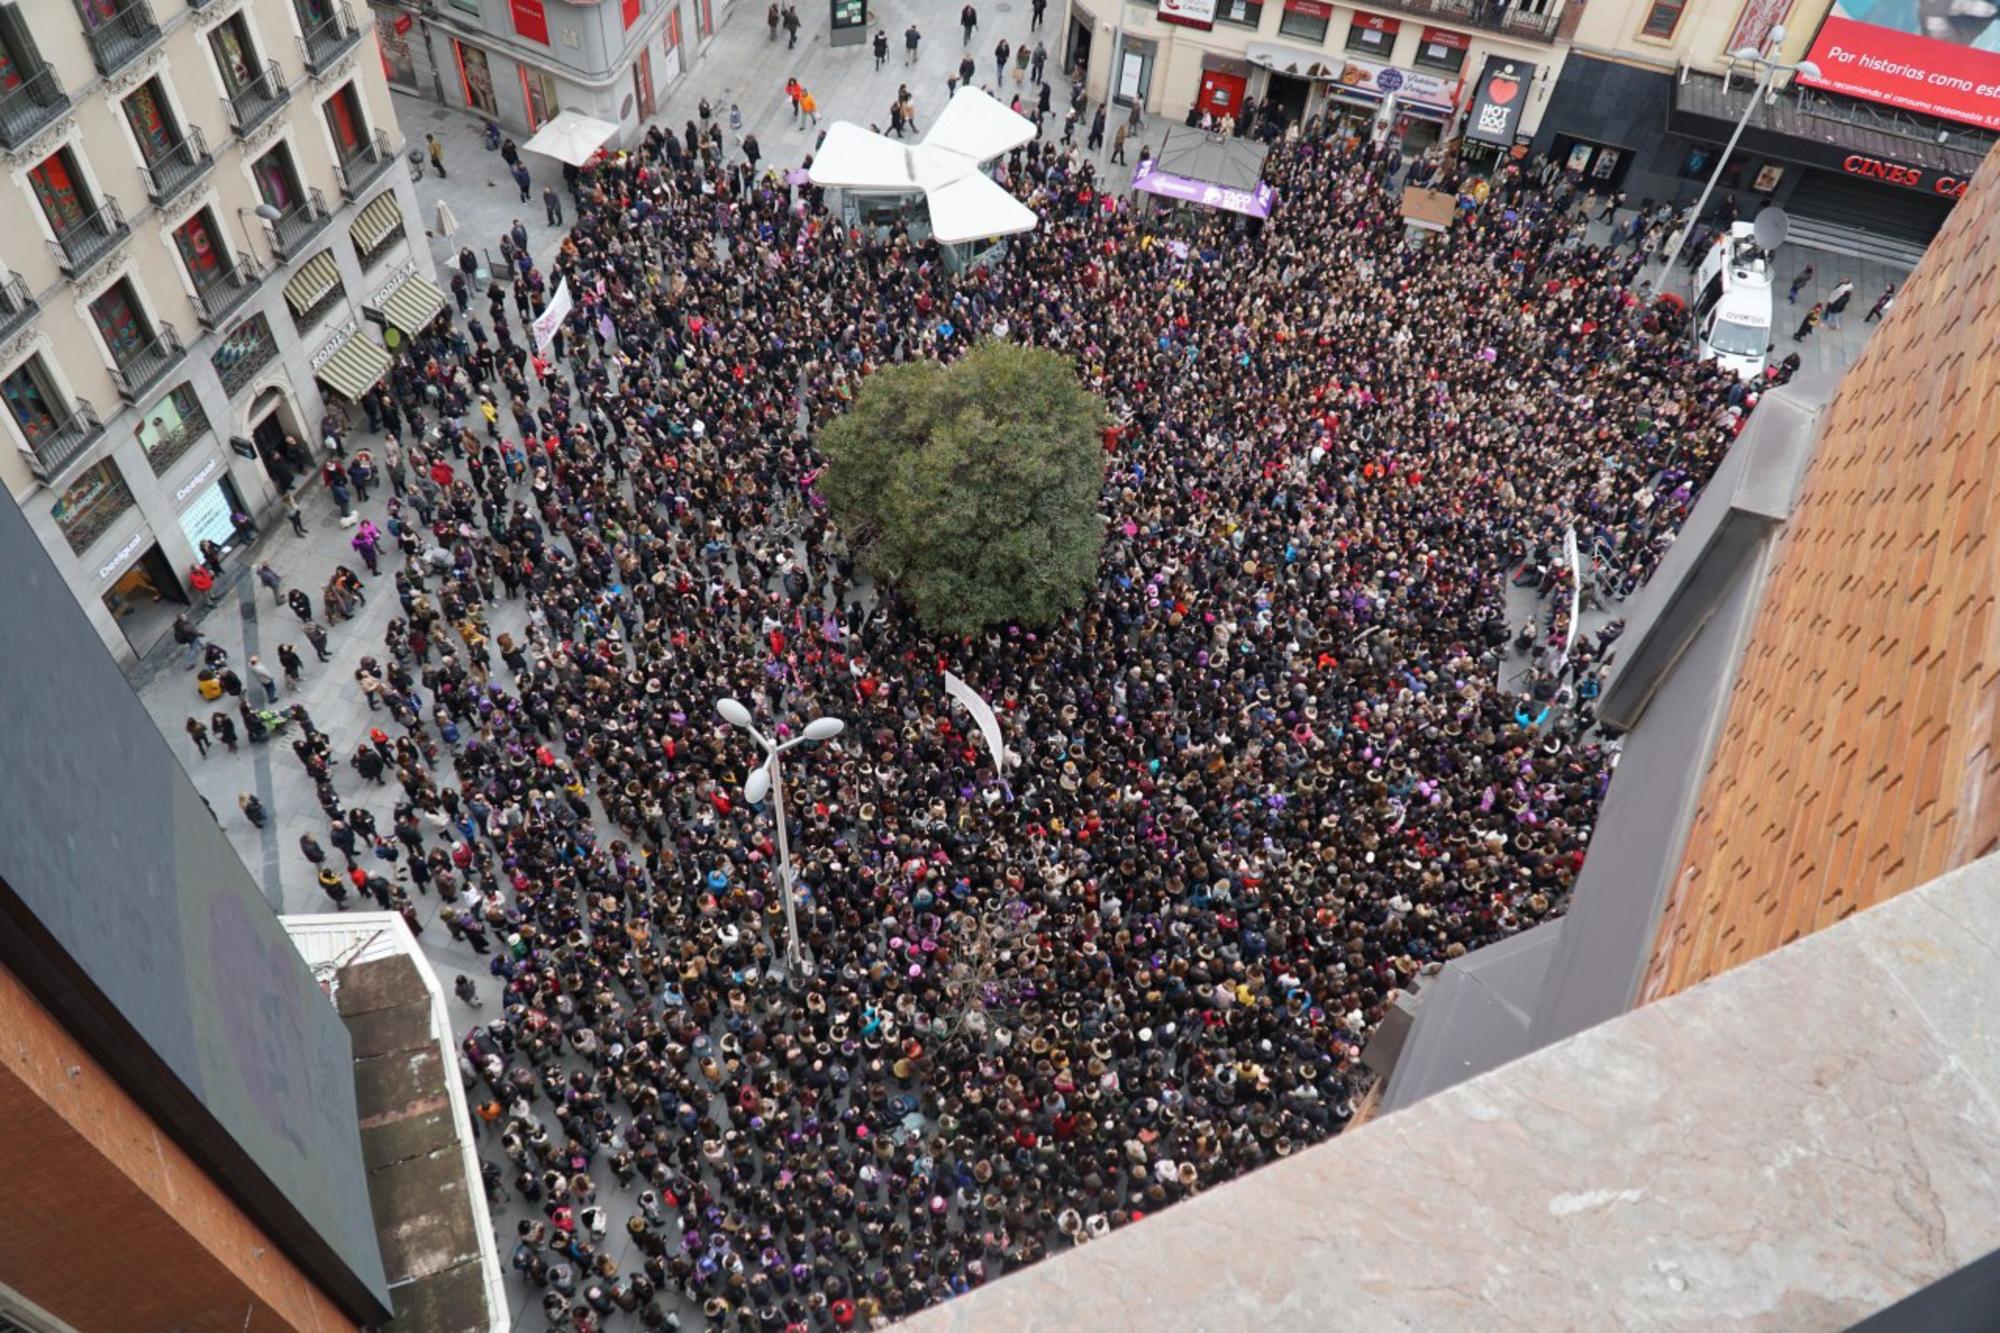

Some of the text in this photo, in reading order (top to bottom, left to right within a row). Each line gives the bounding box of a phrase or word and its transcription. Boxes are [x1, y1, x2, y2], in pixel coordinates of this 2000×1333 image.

[1828, 46, 1857, 63] Por
[1858, 54, 1926, 81] historias
[1927, 73, 1974, 92] como
[1479, 114, 1506, 129] DOG
[1481, 103, 1511, 118] HOT
[1842, 155, 1922, 187] CINES
[1224, 191, 1250, 204] TACO
[176, 459, 216, 501] Desigual
[99, 533, 142, 578] Desigual
